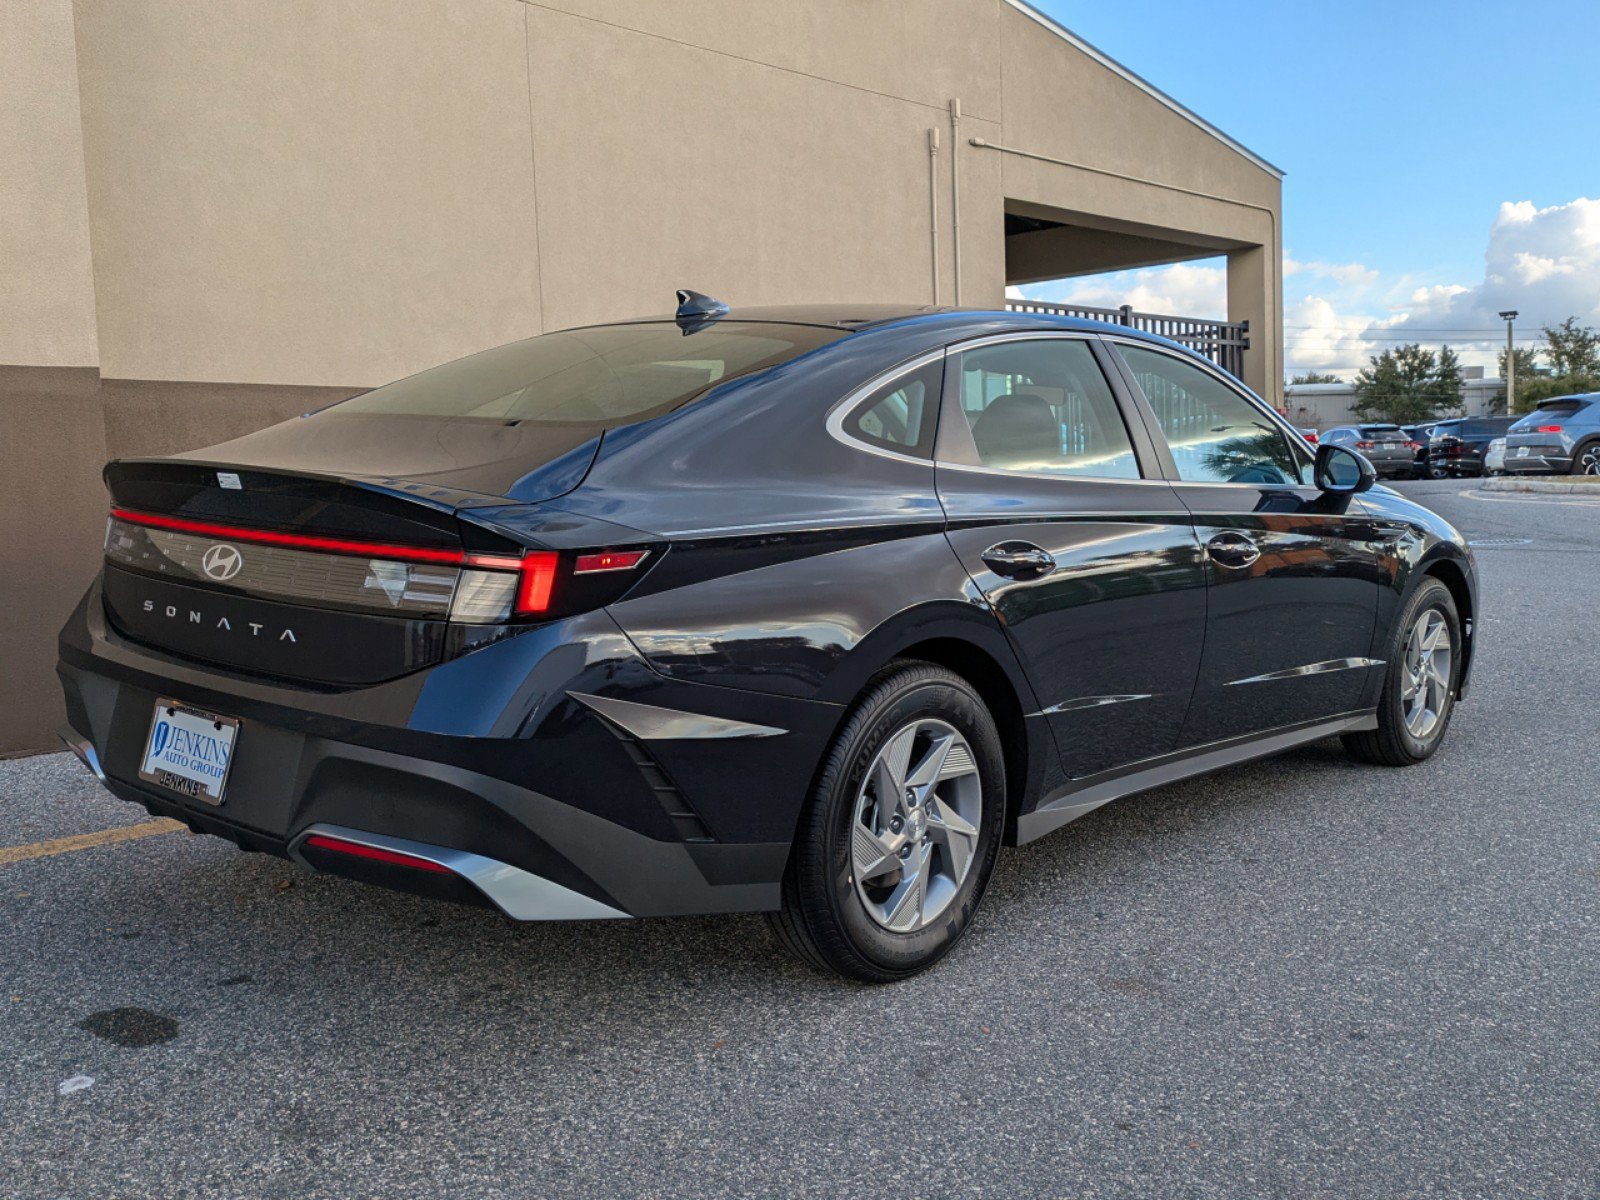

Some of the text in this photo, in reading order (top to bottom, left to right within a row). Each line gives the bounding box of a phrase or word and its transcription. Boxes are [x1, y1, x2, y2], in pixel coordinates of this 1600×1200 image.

[143, 599, 296, 643] SONATA
[166, 725, 231, 766] JENKINS
[163, 751, 225, 778] AUTO GROUP
[159, 771, 198, 796] JENKINS
